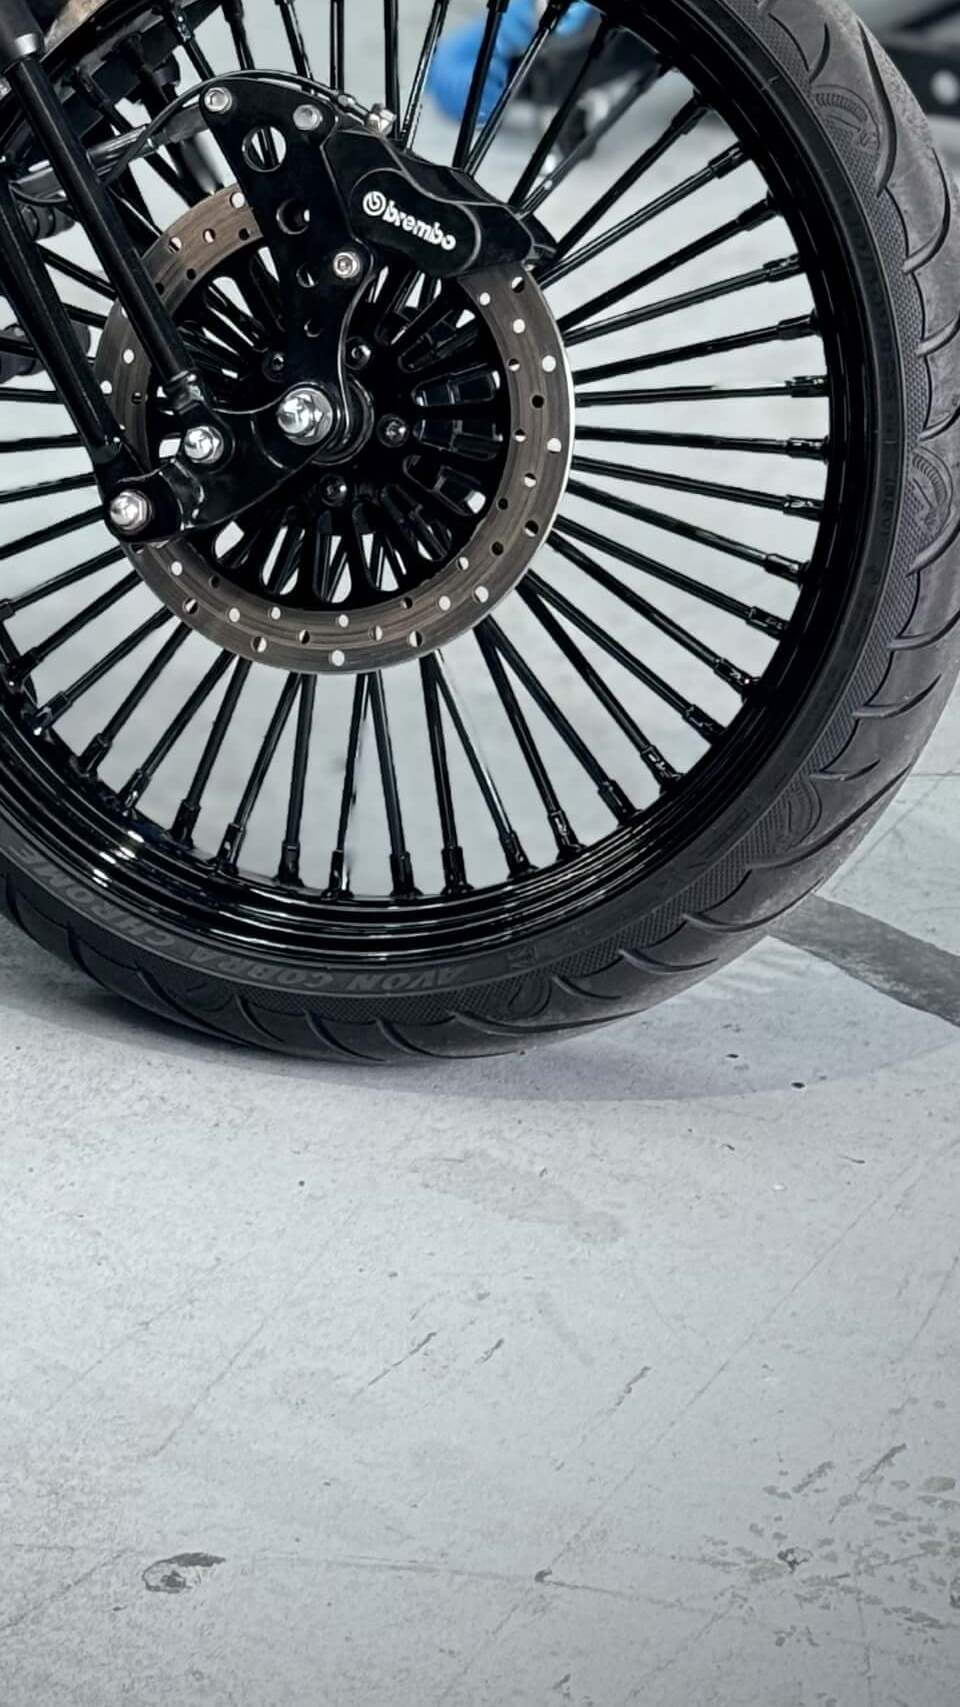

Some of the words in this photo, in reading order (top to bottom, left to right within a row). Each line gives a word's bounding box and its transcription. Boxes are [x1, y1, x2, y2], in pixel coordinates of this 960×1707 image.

[382, 200, 456, 251] brembo
[7, 844, 177, 948] CHROME
[189, 947, 335, 988] COBRA
[344, 963, 468, 992] AVON
